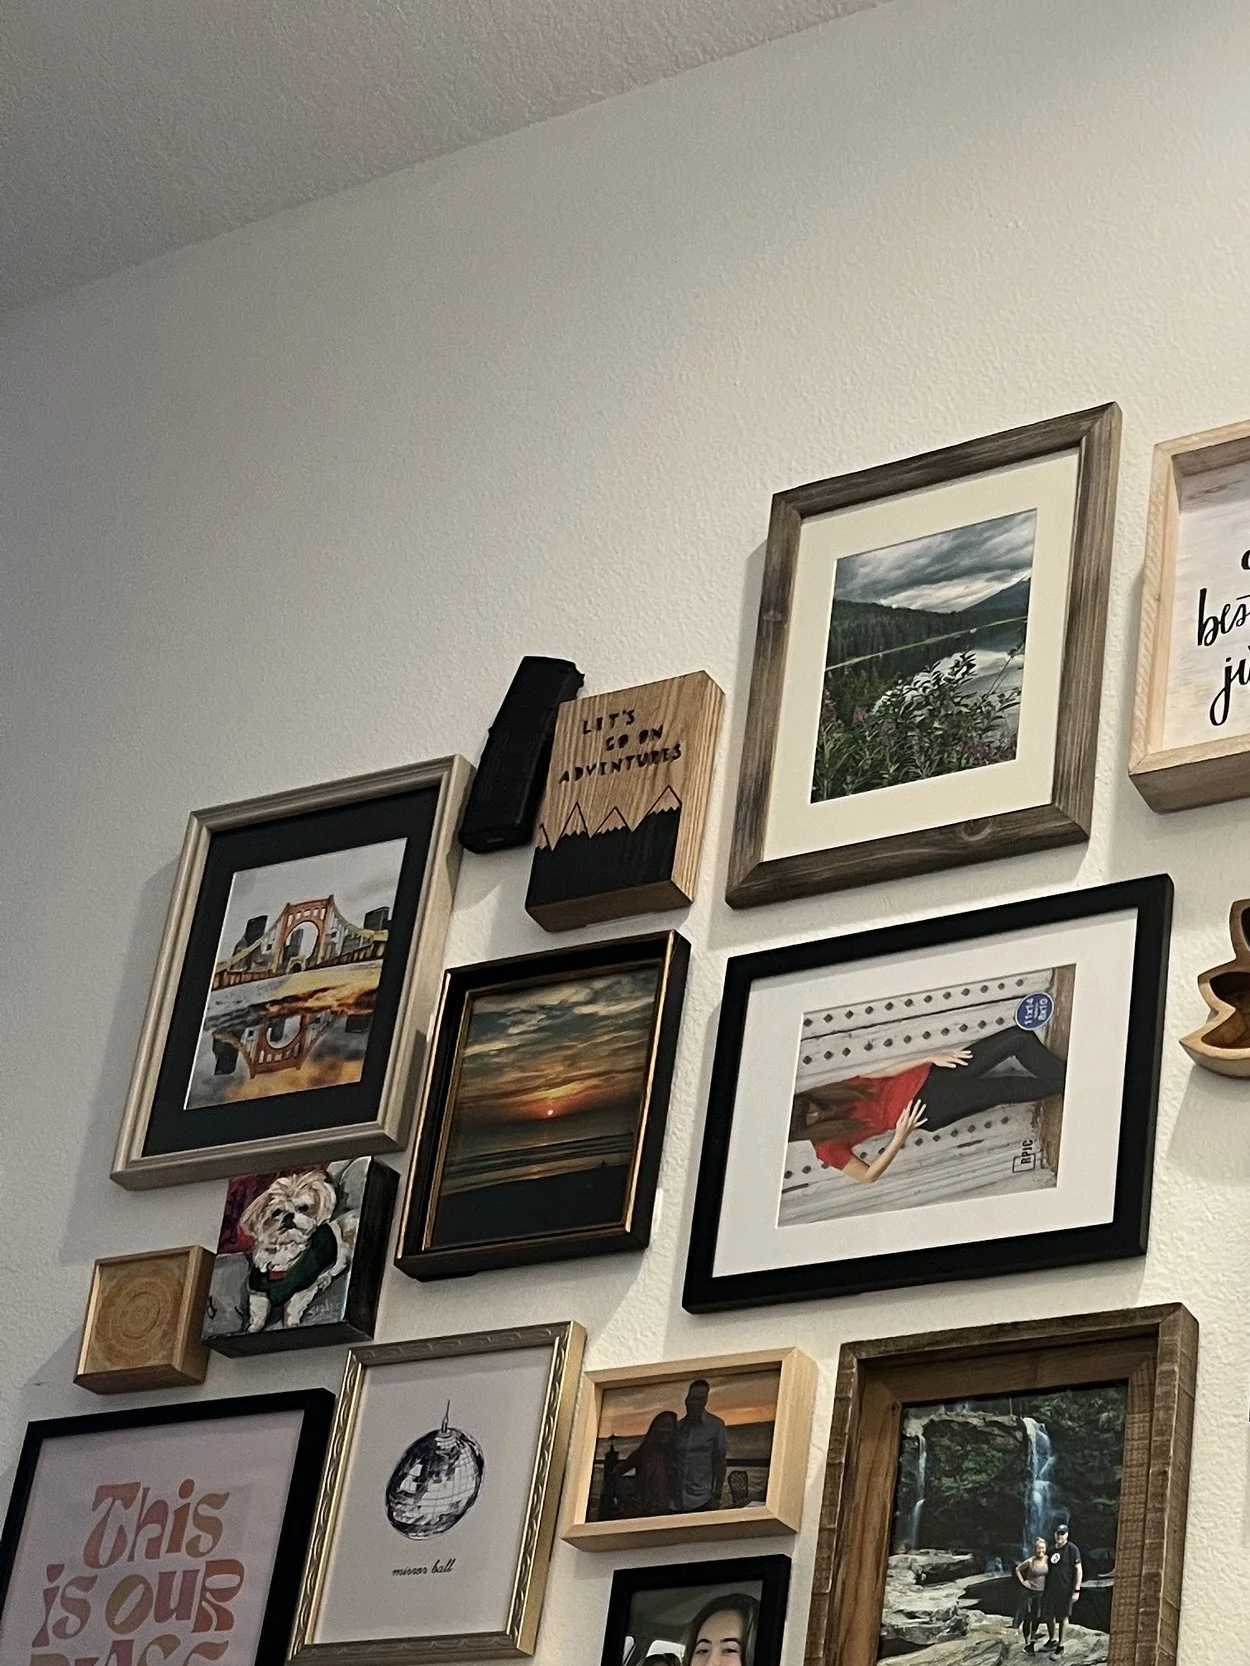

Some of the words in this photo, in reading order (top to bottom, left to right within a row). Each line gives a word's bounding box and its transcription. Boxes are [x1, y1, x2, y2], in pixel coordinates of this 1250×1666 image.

[605, 735, 629, 751] GO
[638, 724, 664, 744] ON
[83, 1478, 230, 1569] This
[391, 1565, 428, 1576] mirror
[431, 1558, 457, 1574] ball
[32, 1563, 98, 1648] is
